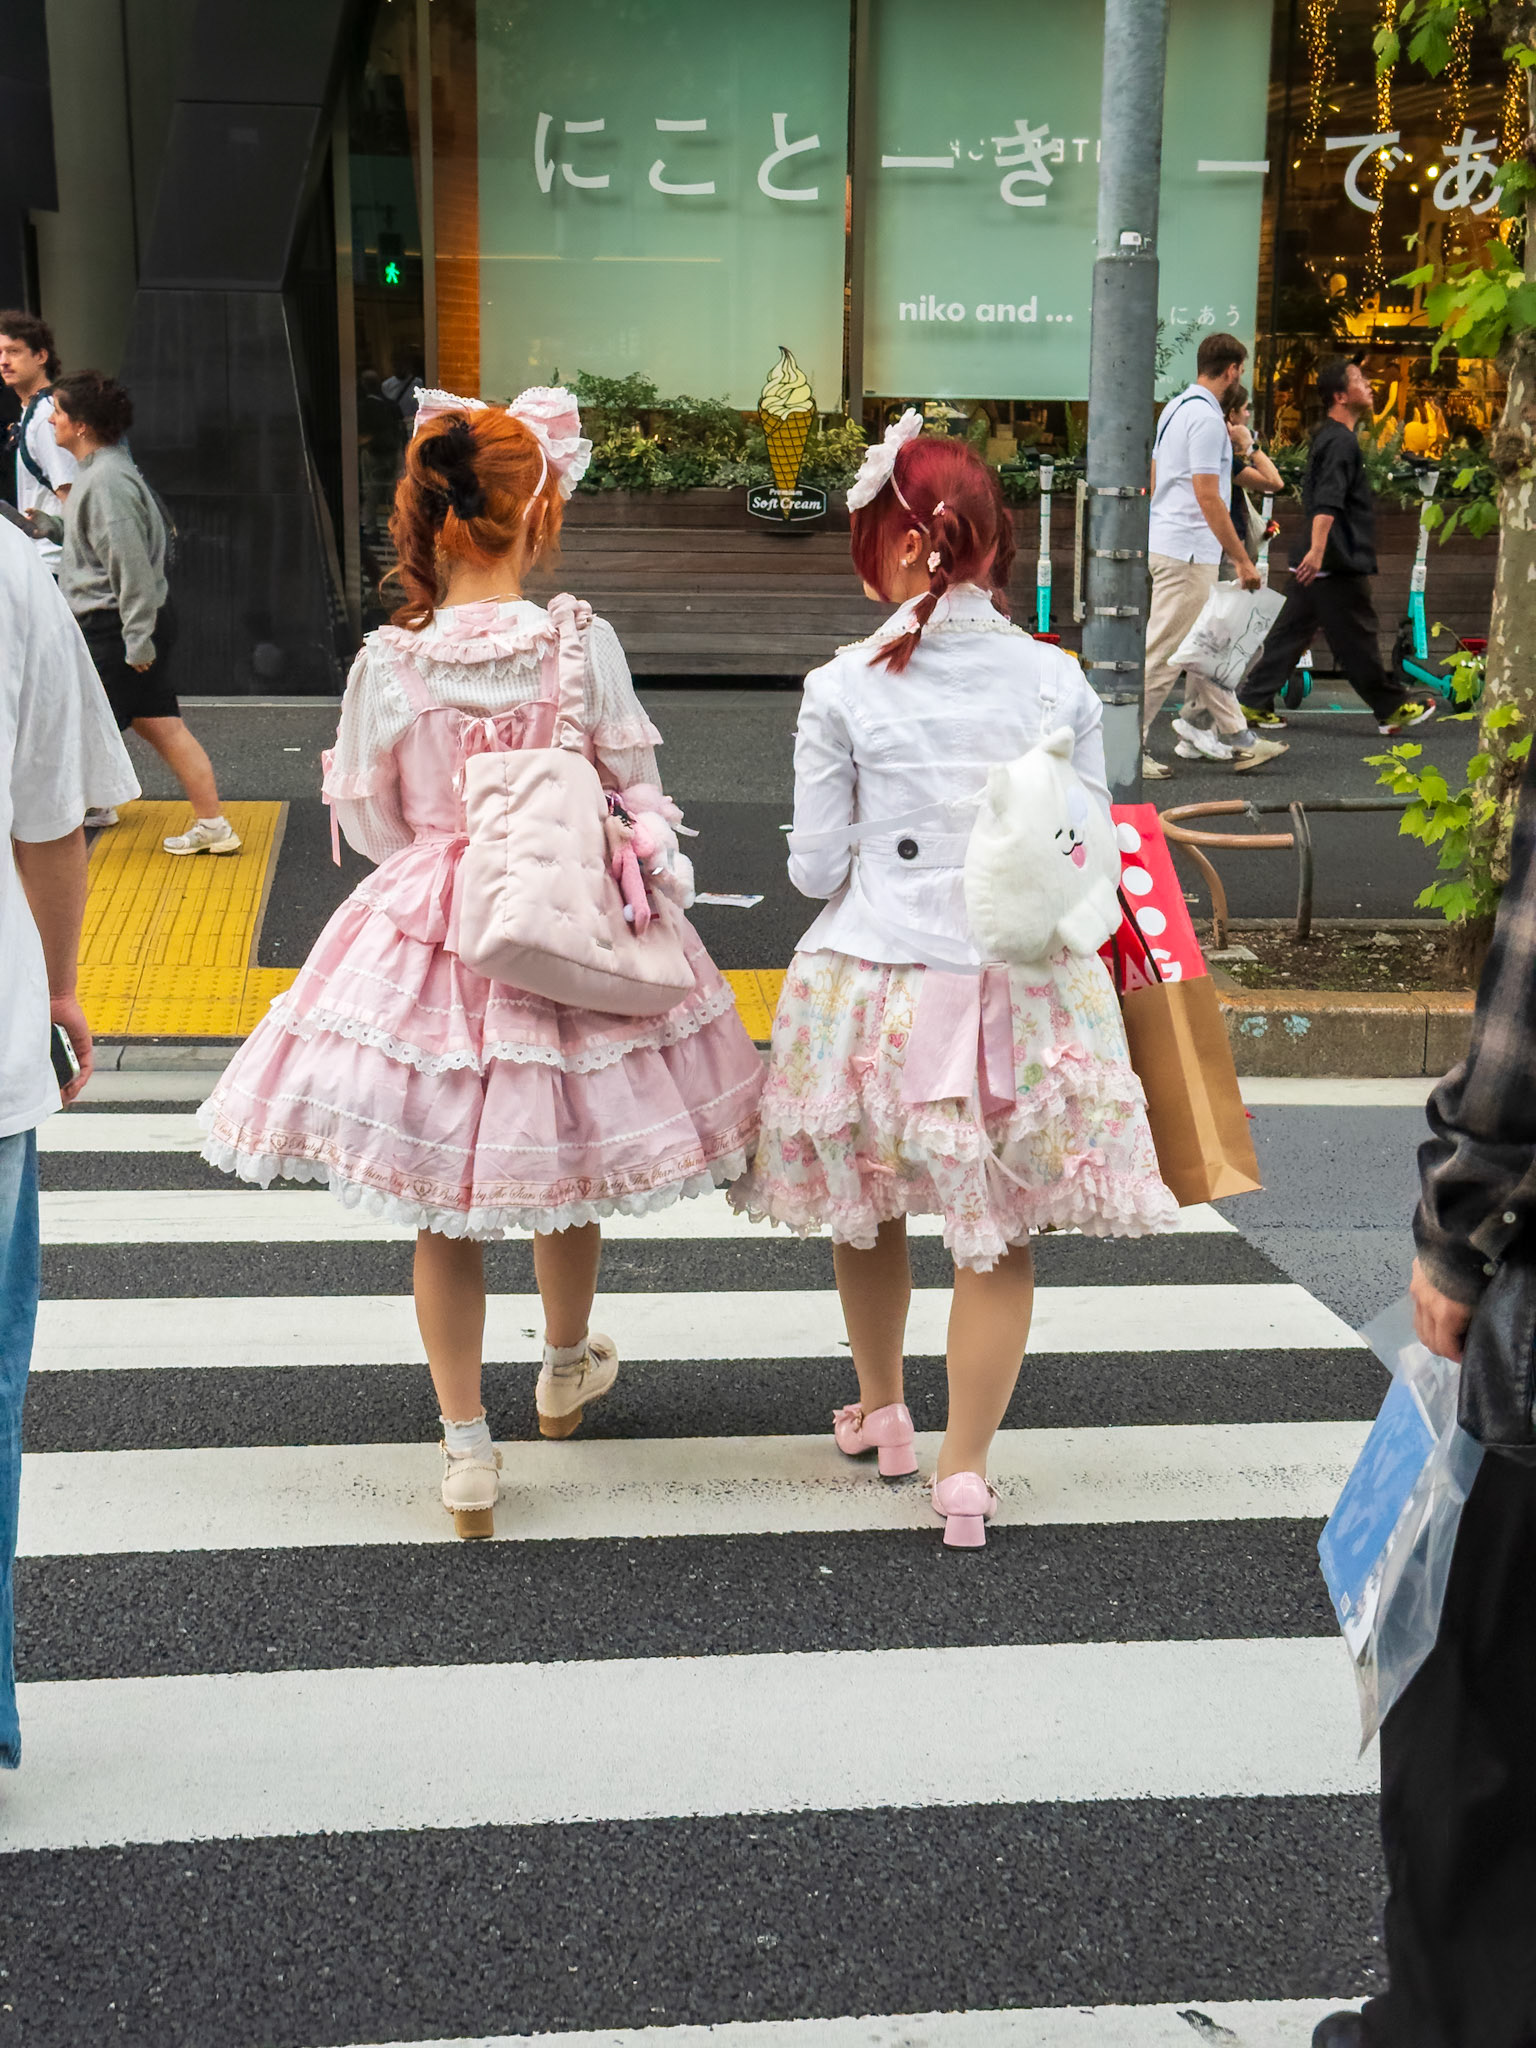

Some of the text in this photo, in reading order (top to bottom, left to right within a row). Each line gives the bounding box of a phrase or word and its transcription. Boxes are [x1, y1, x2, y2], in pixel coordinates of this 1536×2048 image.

[899, 296, 965, 322] niko
[975, 296, 1037, 322] and
[752, 497, 821, 511] Soft Cream
